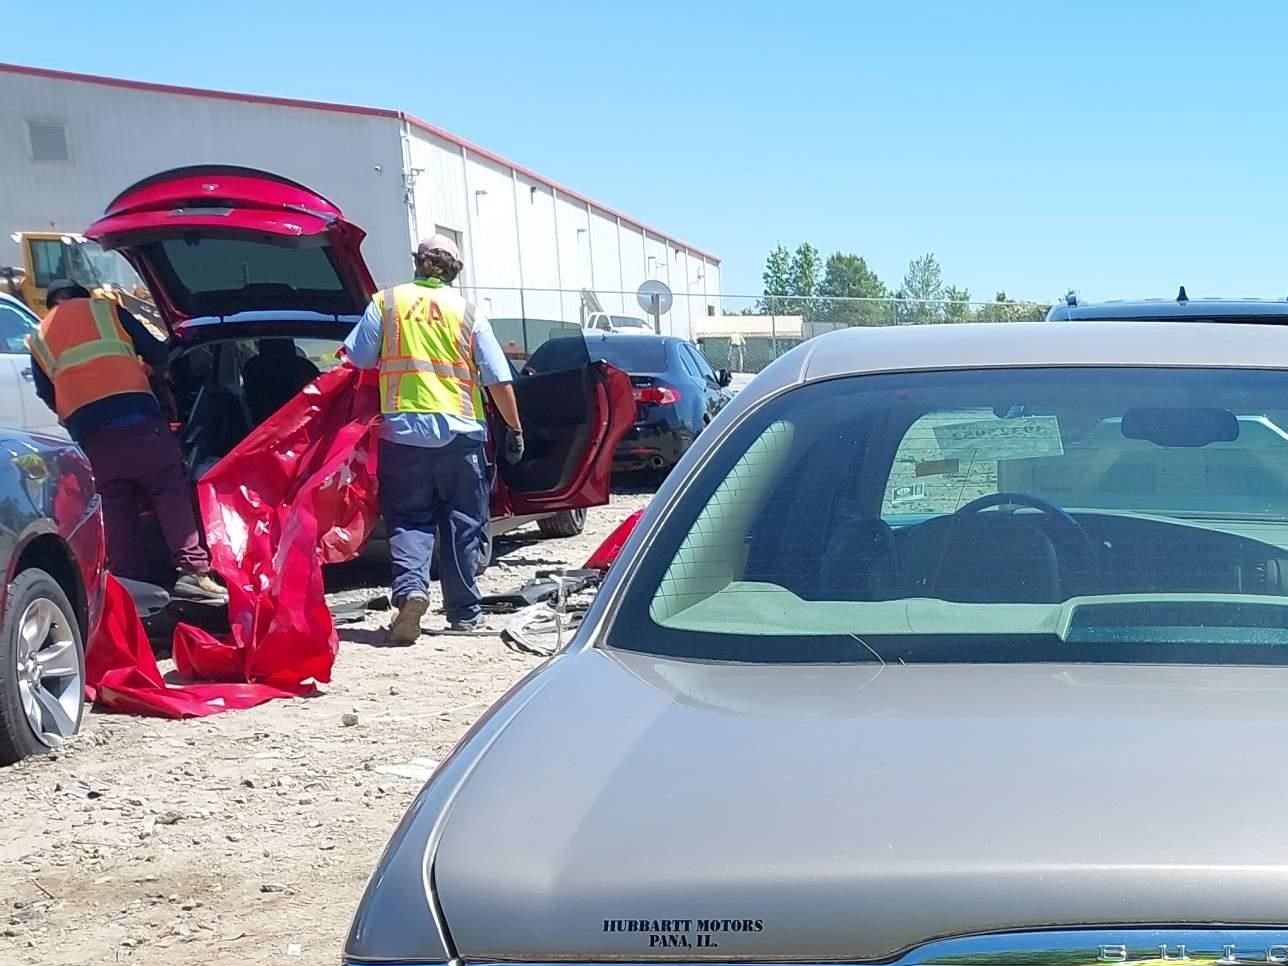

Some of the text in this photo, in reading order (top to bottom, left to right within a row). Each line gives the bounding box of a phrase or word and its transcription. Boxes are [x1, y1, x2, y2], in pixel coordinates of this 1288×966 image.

[603, 919, 763, 932] HUBBARTT MOTORS
[649, 934, 718, 950] PANA, IL.
